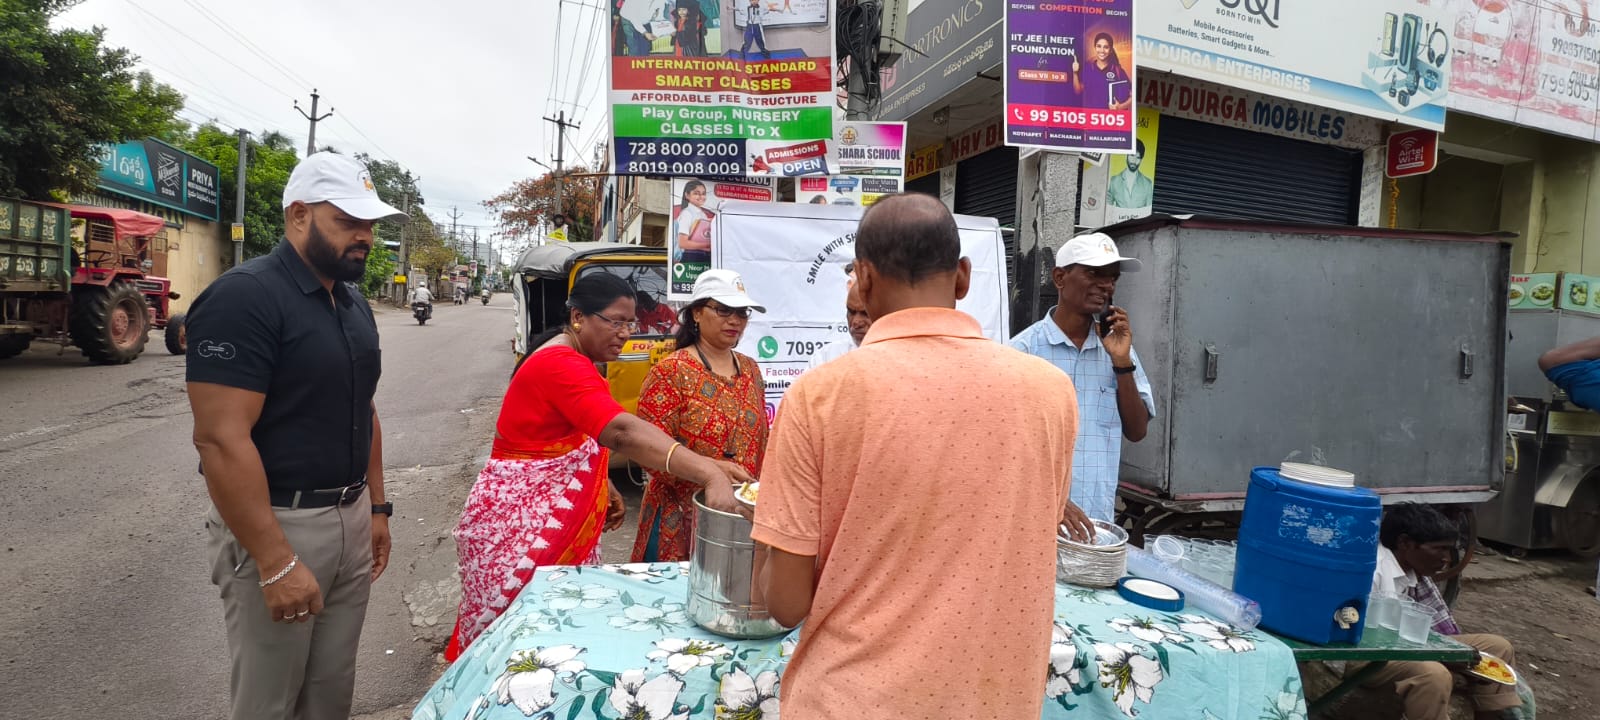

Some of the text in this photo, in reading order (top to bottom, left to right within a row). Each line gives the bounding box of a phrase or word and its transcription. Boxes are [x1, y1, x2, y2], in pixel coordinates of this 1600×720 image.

[1011, 2, 1129, 17] BEFORE COMPETITION BEGINS
[1216, 7, 1262, 25] BORN TO WIN
[902, 1, 984, 70] PORTRONICS
[1168, 24, 1200, 40] Batteries,
[1201, 32, 1220, 44] Smart
[1221, 37, 1247, 52] Gadgets
[1248, 44, 1253, 52] &
[1193, 19, 1255, 42] Mobile Accessories
[1011, 33, 1076, 46] IIT JEE NEET
[1011, 44, 1076, 57] FOUNDATION
[631, 59, 817, 75] INTERNATIONAL STANDARD
[1159, 44, 1212, 70] DURGA
[1216, 57, 1312, 93] ENTERPRISES
[655, 74, 792, 91] SMART CLASSES
[1019, 71, 1038, 80] Class
[631, 92, 817, 106] AFFORDABLE FEE STRUCTURE
[642, 107, 801, 123] Play Group, NURSERY
[1030, 110, 1125, 127] 99 5105 5105
[1178, 86, 1248, 123] DURGA
[1252, 101, 1346, 140] MOBILES
[660, 123, 734, 136] CLASSES
[749, 125, 766, 137] To
[769, 126, 781, 138] X
[628, 142, 739, 156] 728 800 2000
[768, 143, 820, 161] ADMISSIONS
[867, 148, 901, 161] SCHOOL
[1398, 145, 1425, 157] Airtel
[628, 161, 741, 175] 8019 008 009
[783, 158, 822, 175] OPEN
[191, 168, 214, 189] PRIYA
[806, 252, 826, 285] SMILE
[823, 237, 844, 255] WITH
